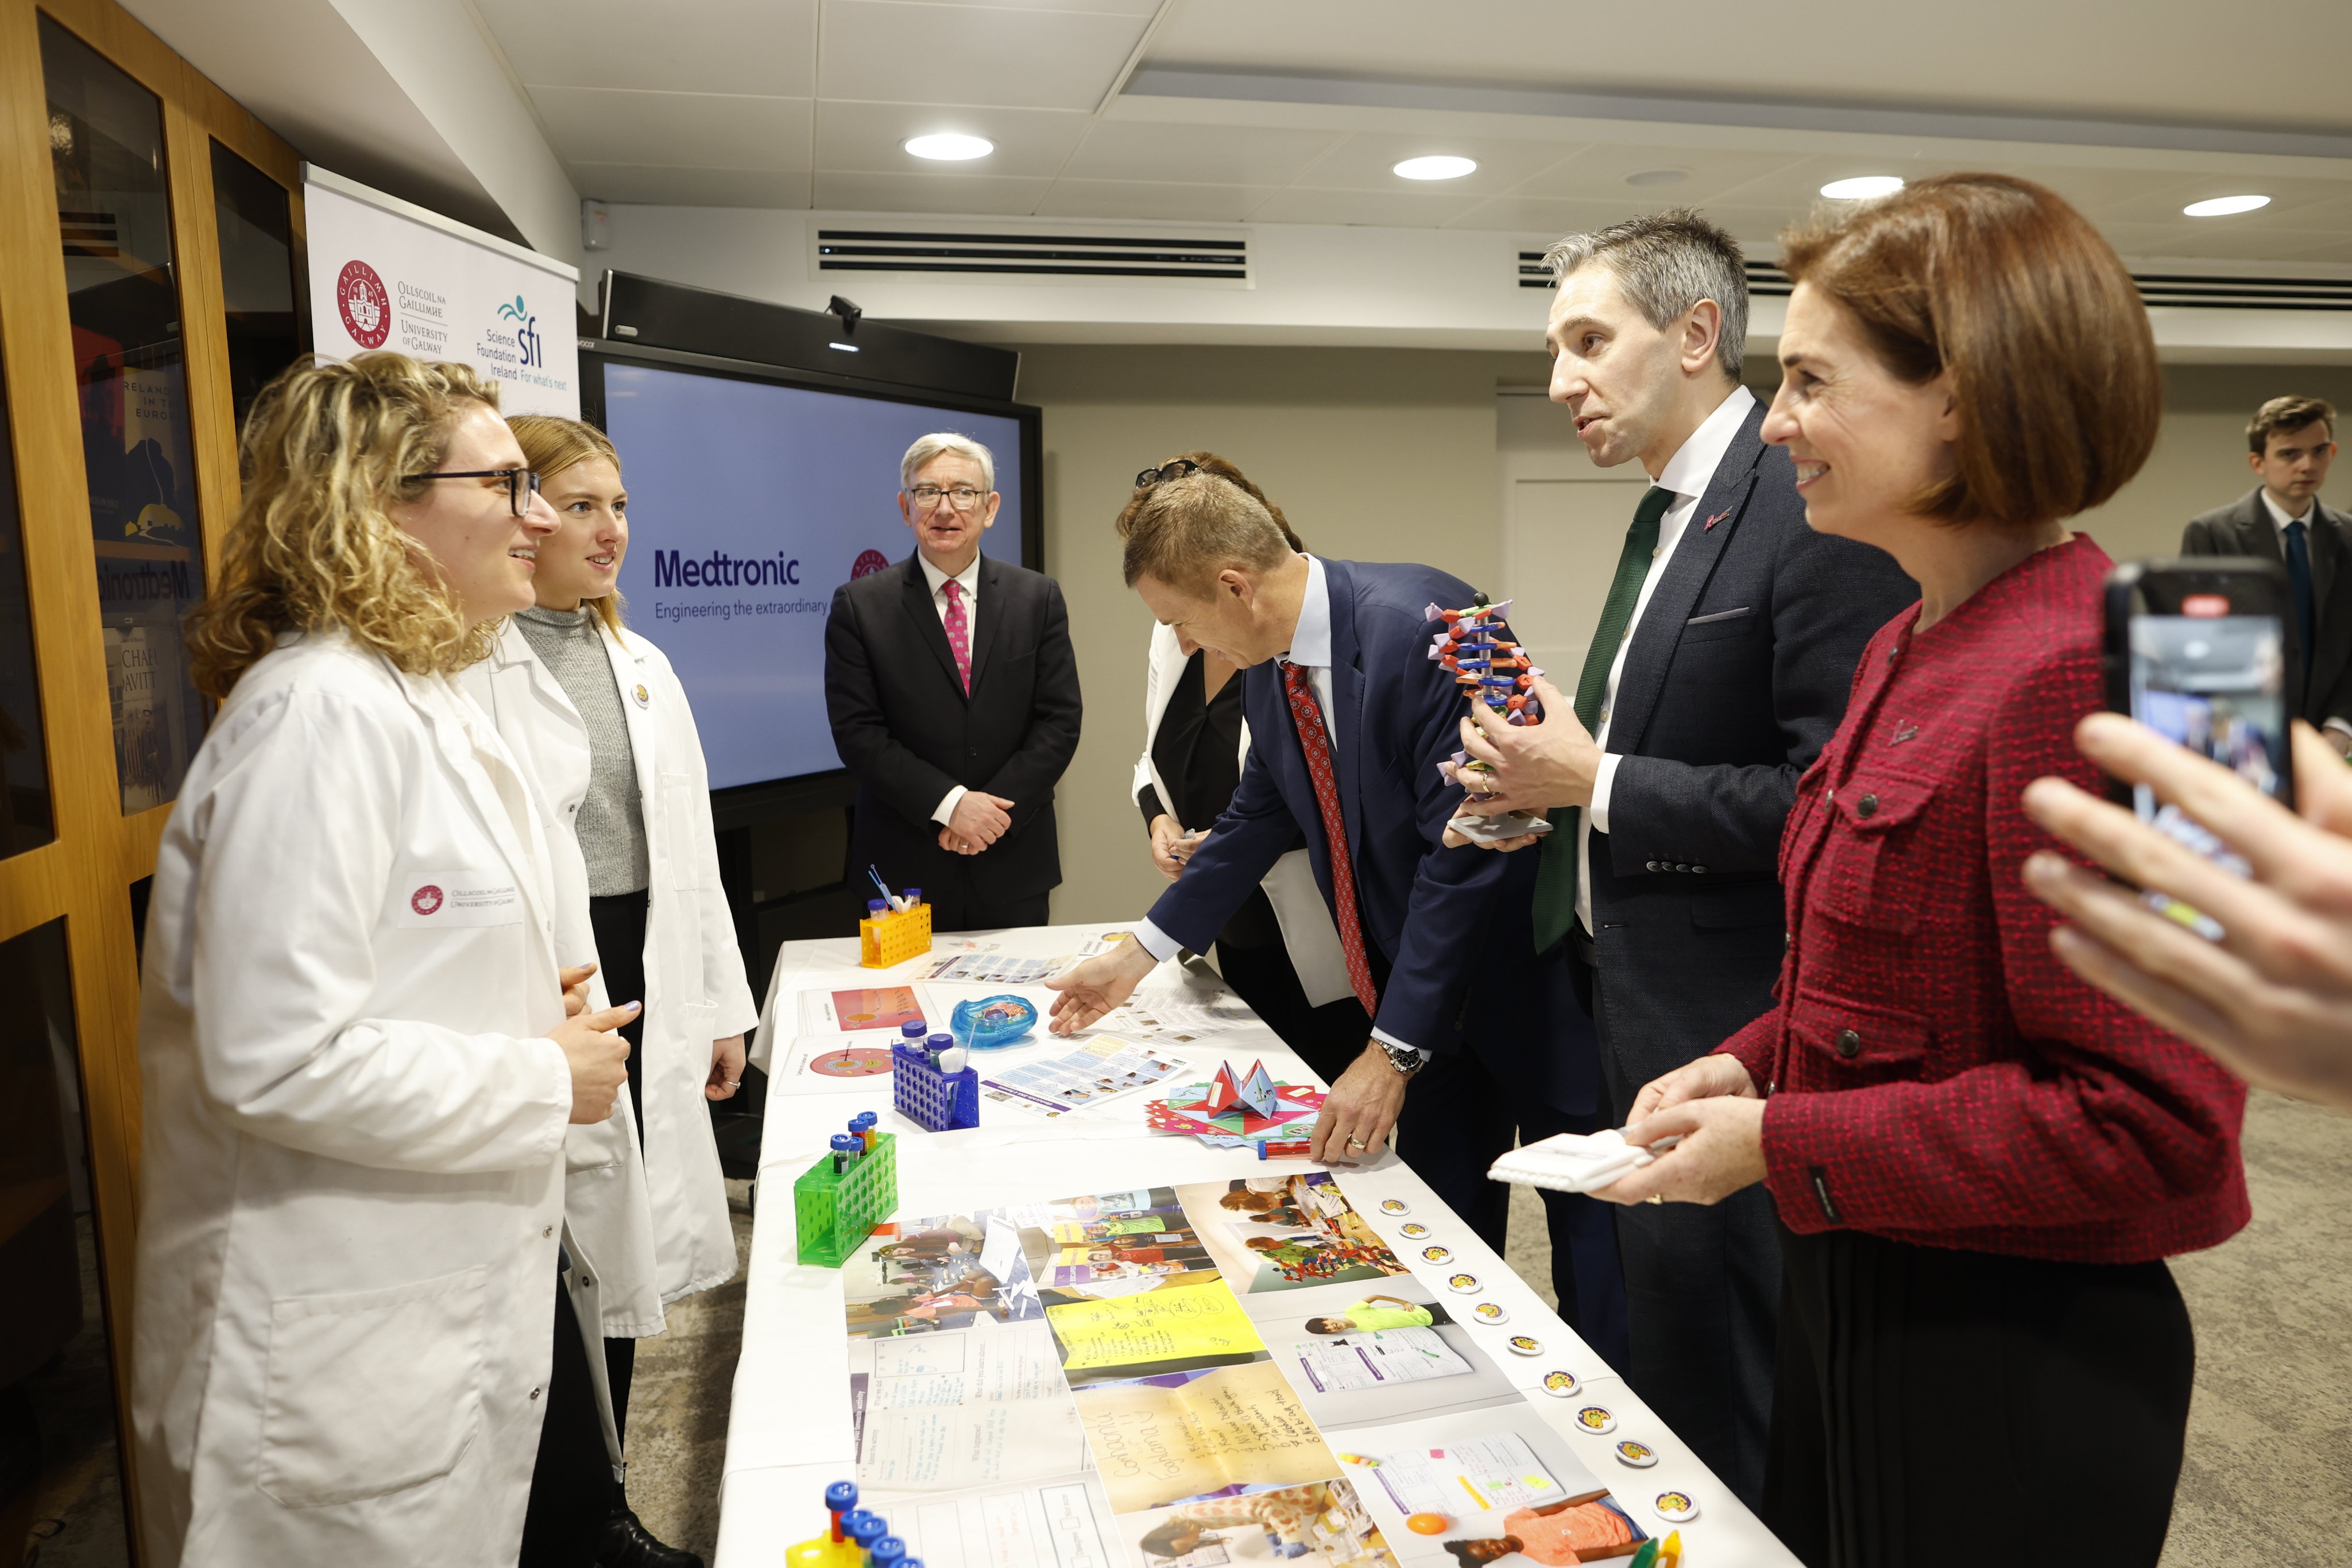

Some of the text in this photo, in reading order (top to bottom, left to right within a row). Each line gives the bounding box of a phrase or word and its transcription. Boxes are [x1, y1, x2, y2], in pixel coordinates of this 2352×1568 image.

[340, 265, 386, 305] GAILLIMH
[398, 281, 446, 304] OLLSCOIL NA
[400, 296, 442, 318] GAILLIMHE
[345, 316, 386, 344] GALWAY
[401, 320, 447, 342] UNIVERSITY
[487, 329, 514, 347] Science
[403, 337, 442, 354] OF GALWAY
[477, 343, 516, 363] Foundation
[491, 363, 517, 380] Ireland
[521, 370, 567, 390] For what's next
[124, 382, 170, 395] RELAND
[144, 397, 155, 405] IN
[655, 549, 799, 587] Medtronic
[656, 598, 827, 622] Engineering the extraordinary
[856, 1391, 865, 1410] activity
[972, 1424, 982, 1462] What happened?
[1140, 1425, 1185, 1480] Foghlama
[1259, 1443, 1275, 1451] 5
[1290, 1439, 1303, 1447] 7
